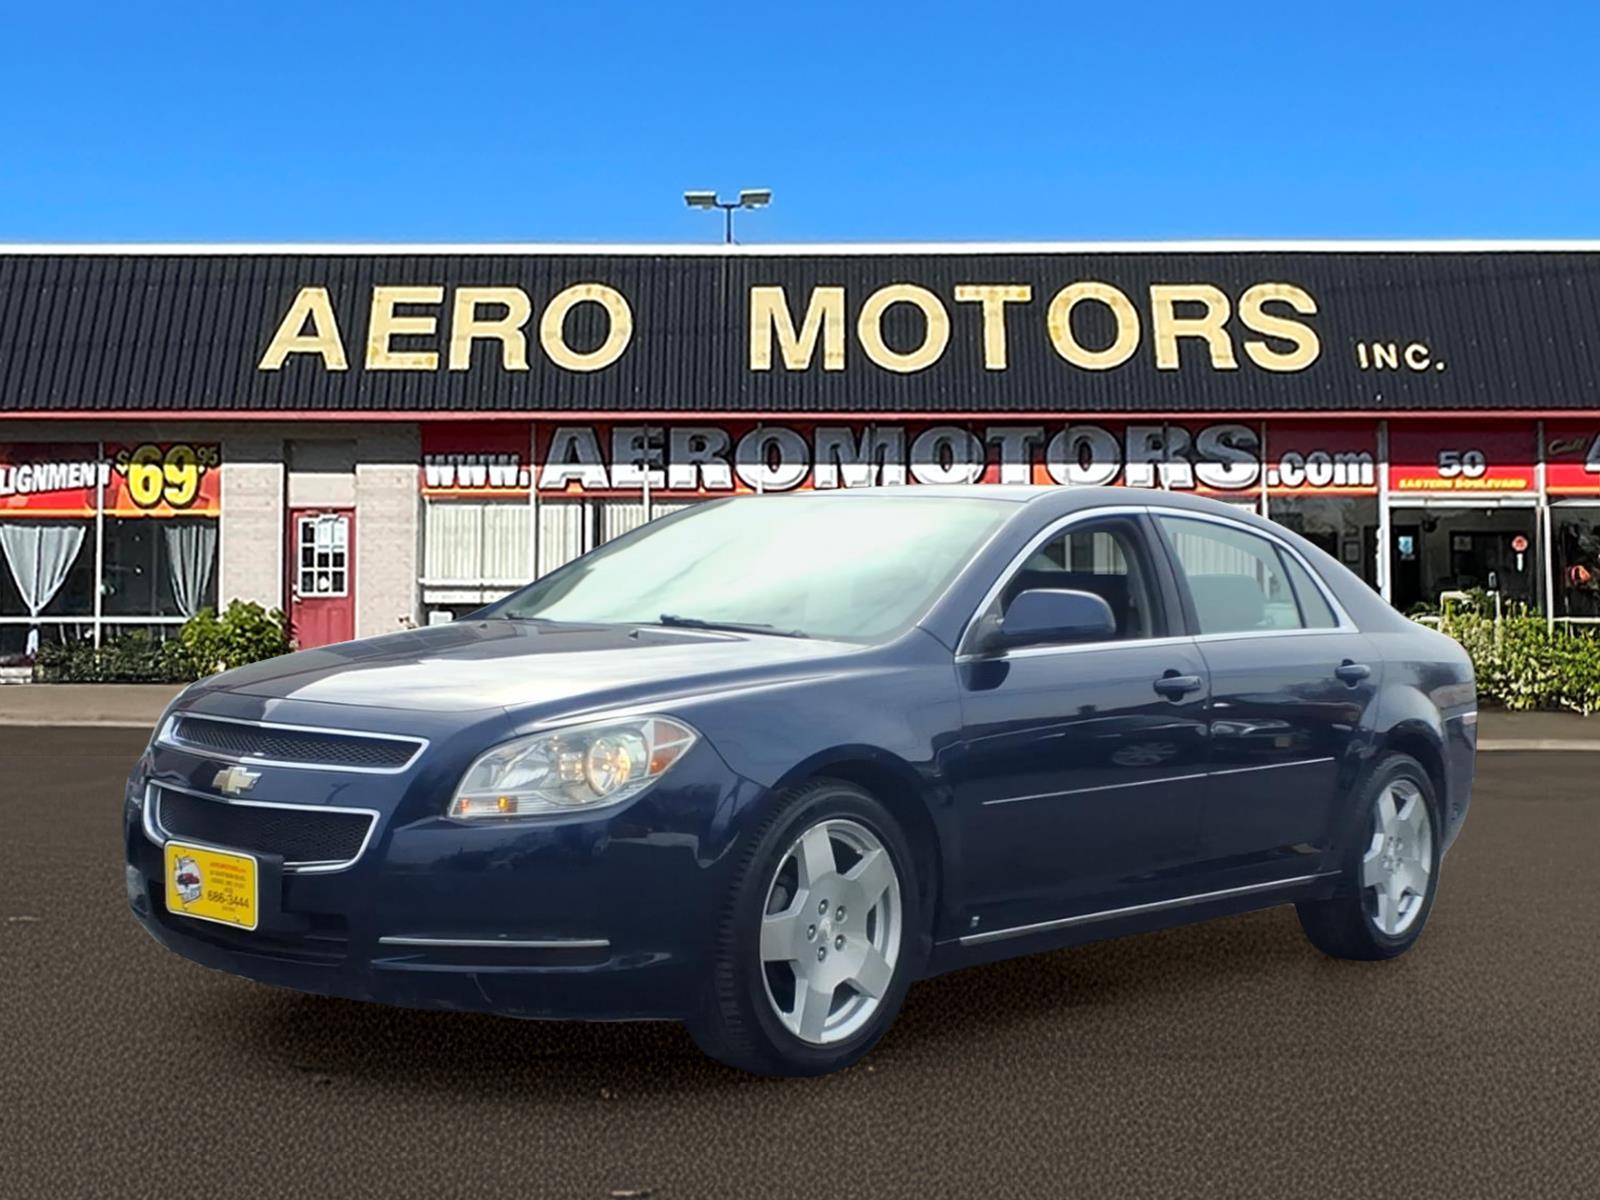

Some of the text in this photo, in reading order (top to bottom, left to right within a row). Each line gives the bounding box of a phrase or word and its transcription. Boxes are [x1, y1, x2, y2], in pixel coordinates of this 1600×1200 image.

[258, 280, 1447, 375] AERO MOTORS INC.
[1438, 451, 1486, 477] 50
